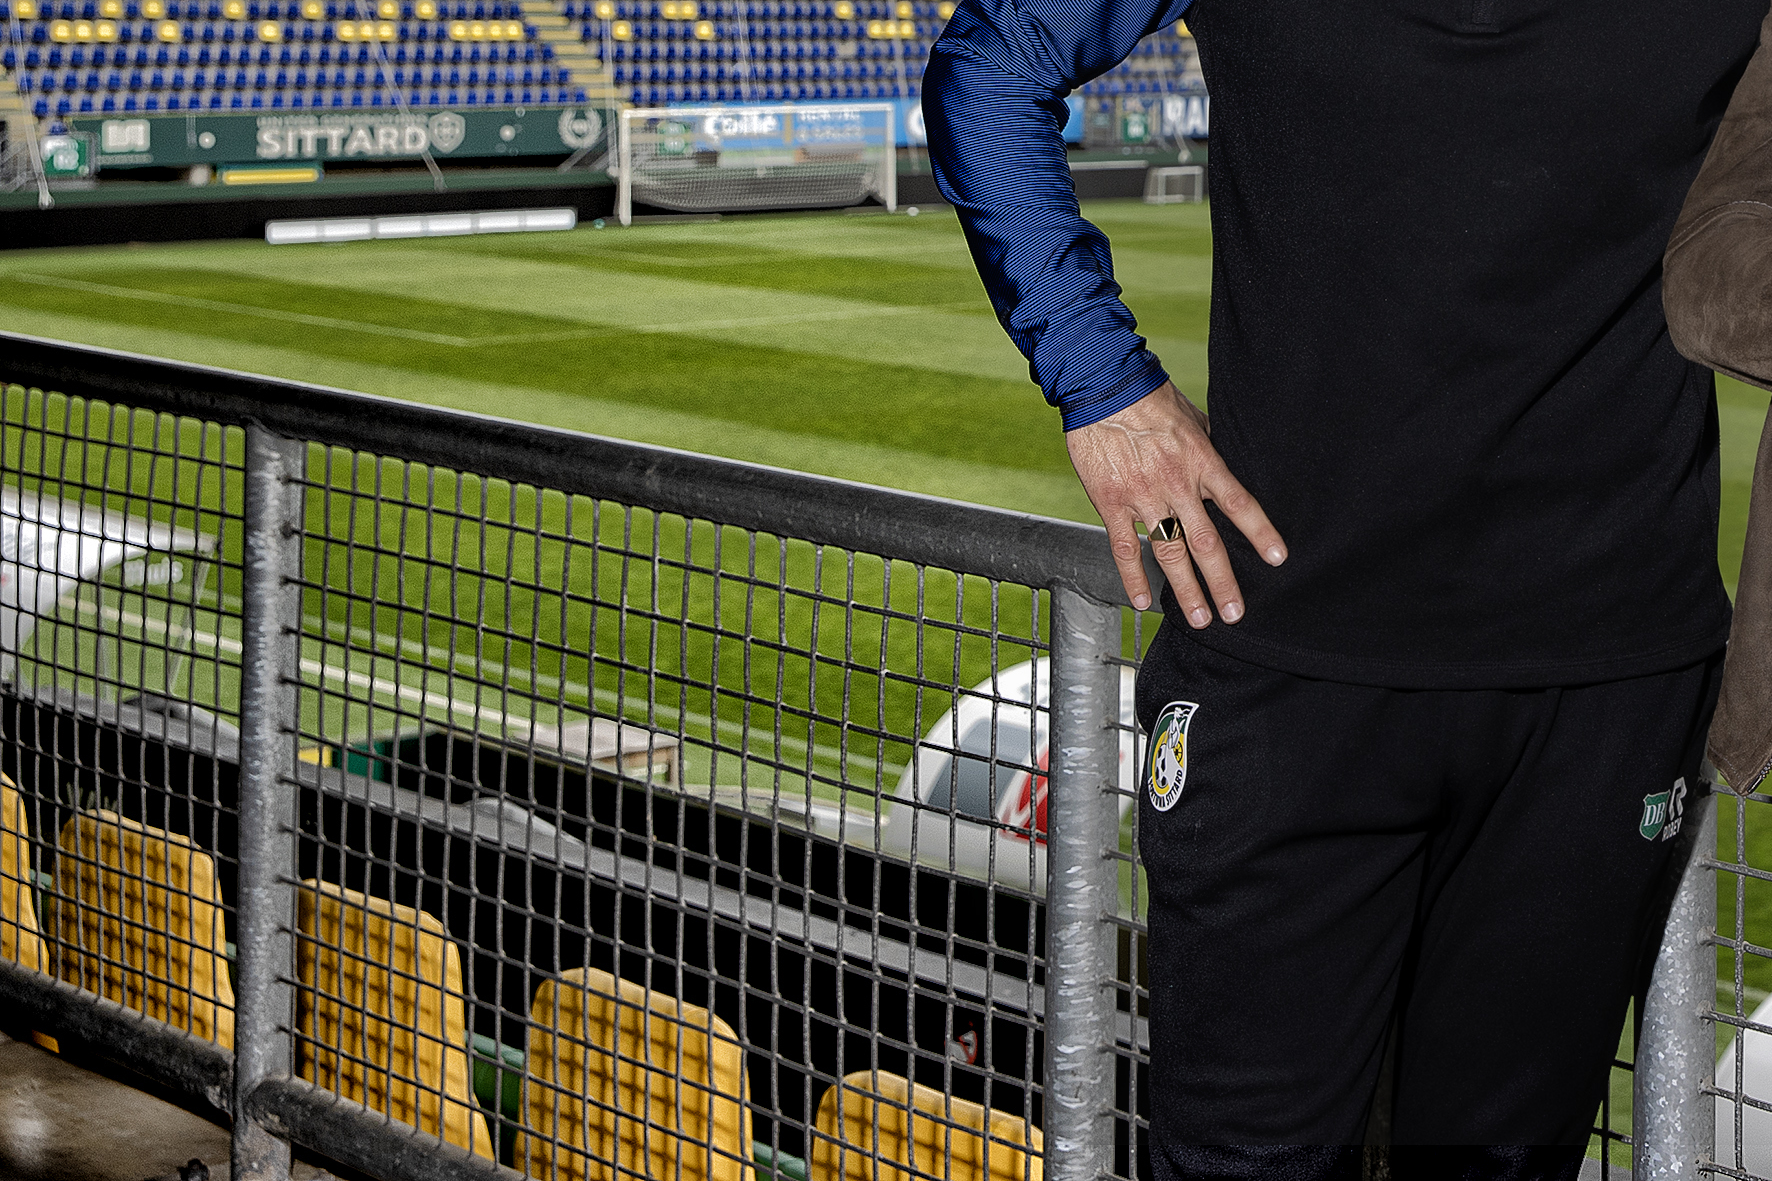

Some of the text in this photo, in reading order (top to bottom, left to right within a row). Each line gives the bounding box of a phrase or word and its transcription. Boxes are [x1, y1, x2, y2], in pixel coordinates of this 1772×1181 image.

[256, 125, 431, 158] SITTARD
[1165, 769, 1183, 806] SITTARD
[1643, 802, 1666, 827] DB
